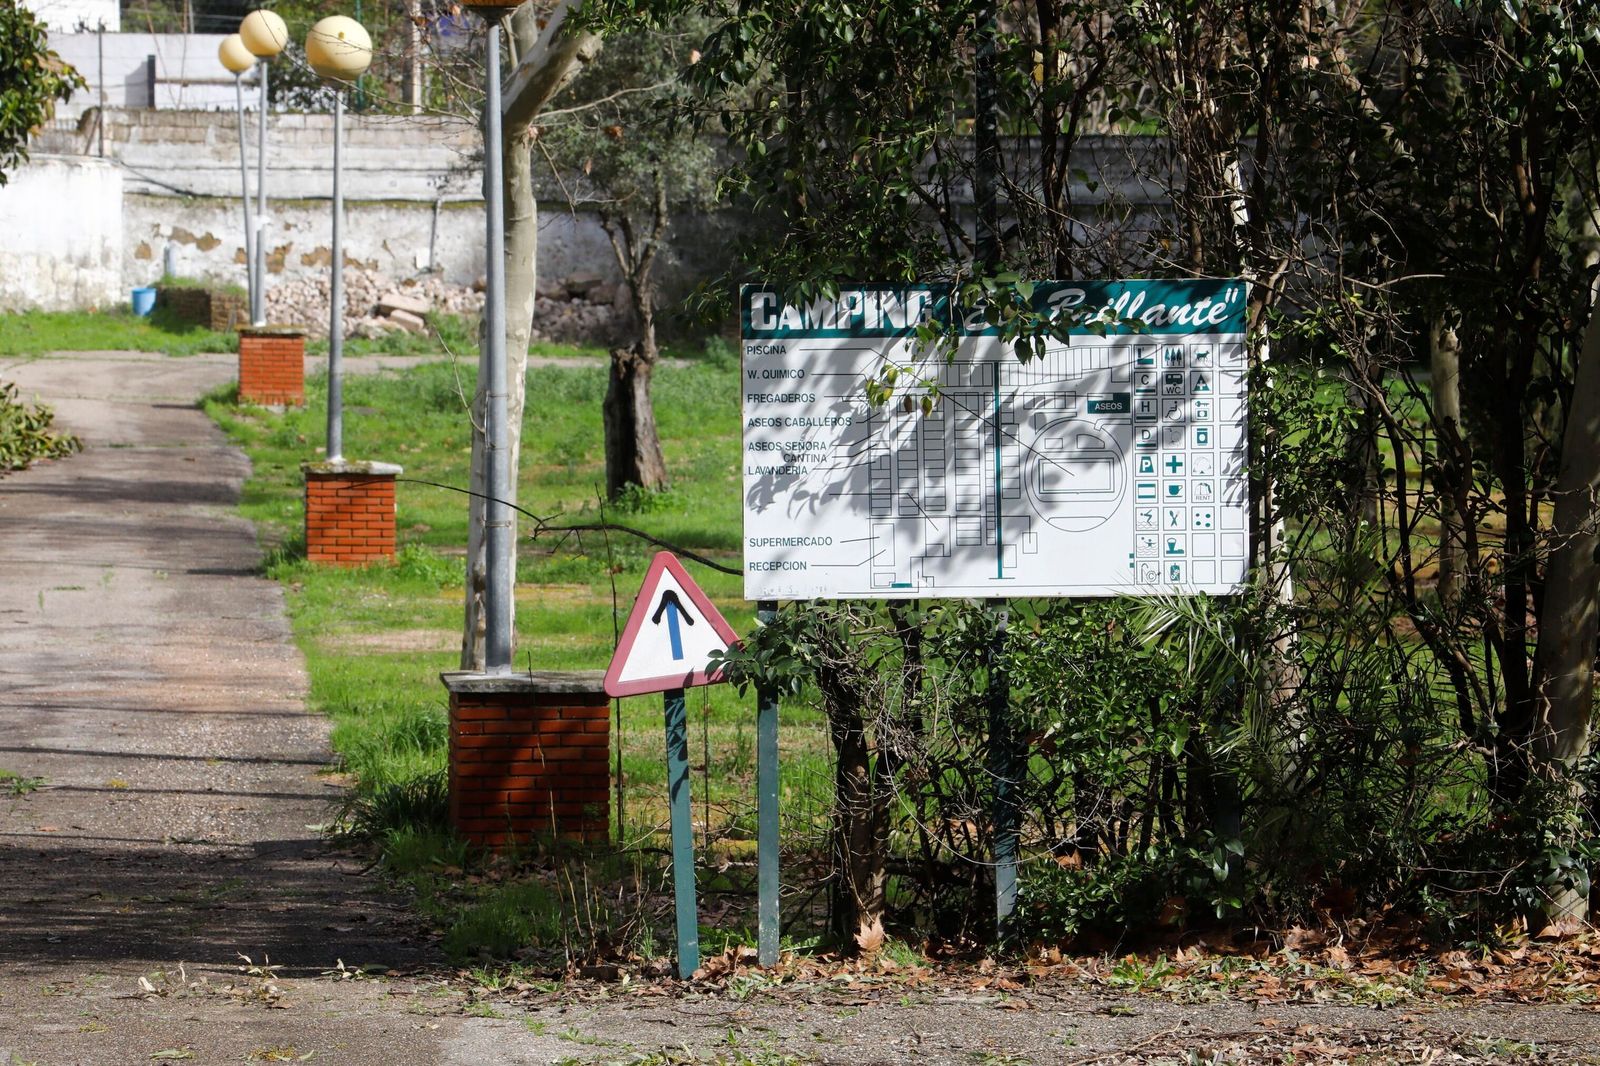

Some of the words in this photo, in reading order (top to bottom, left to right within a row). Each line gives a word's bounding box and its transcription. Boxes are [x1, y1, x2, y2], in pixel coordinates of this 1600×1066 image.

[751, 290, 933, 331] CAMPING
[746, 345, 787, 355] PISCINA
[747, 369, 760, 380] W.
[762, 369, 805, 379] QUIMICO
[1166, 386, 1181, 395] WC
[747, 393, 816, 403] FREGADEROS
[1094, 402, 1123, 411] ASEOS
[748, 417, 783, 428] ASEOS
[784, 417, 852, 427] CABALLEROS
[748, 441, 782, 452] ASEOS
[783, 453, 827, 463] CANTINA
[748, 466, 808, 476] LAVANDERIA
[1142, 460, 1151, 472] P
[749, 537, 833, 547] SUPERMERCADO
[749, 561, 807, 571] RECEPCION
